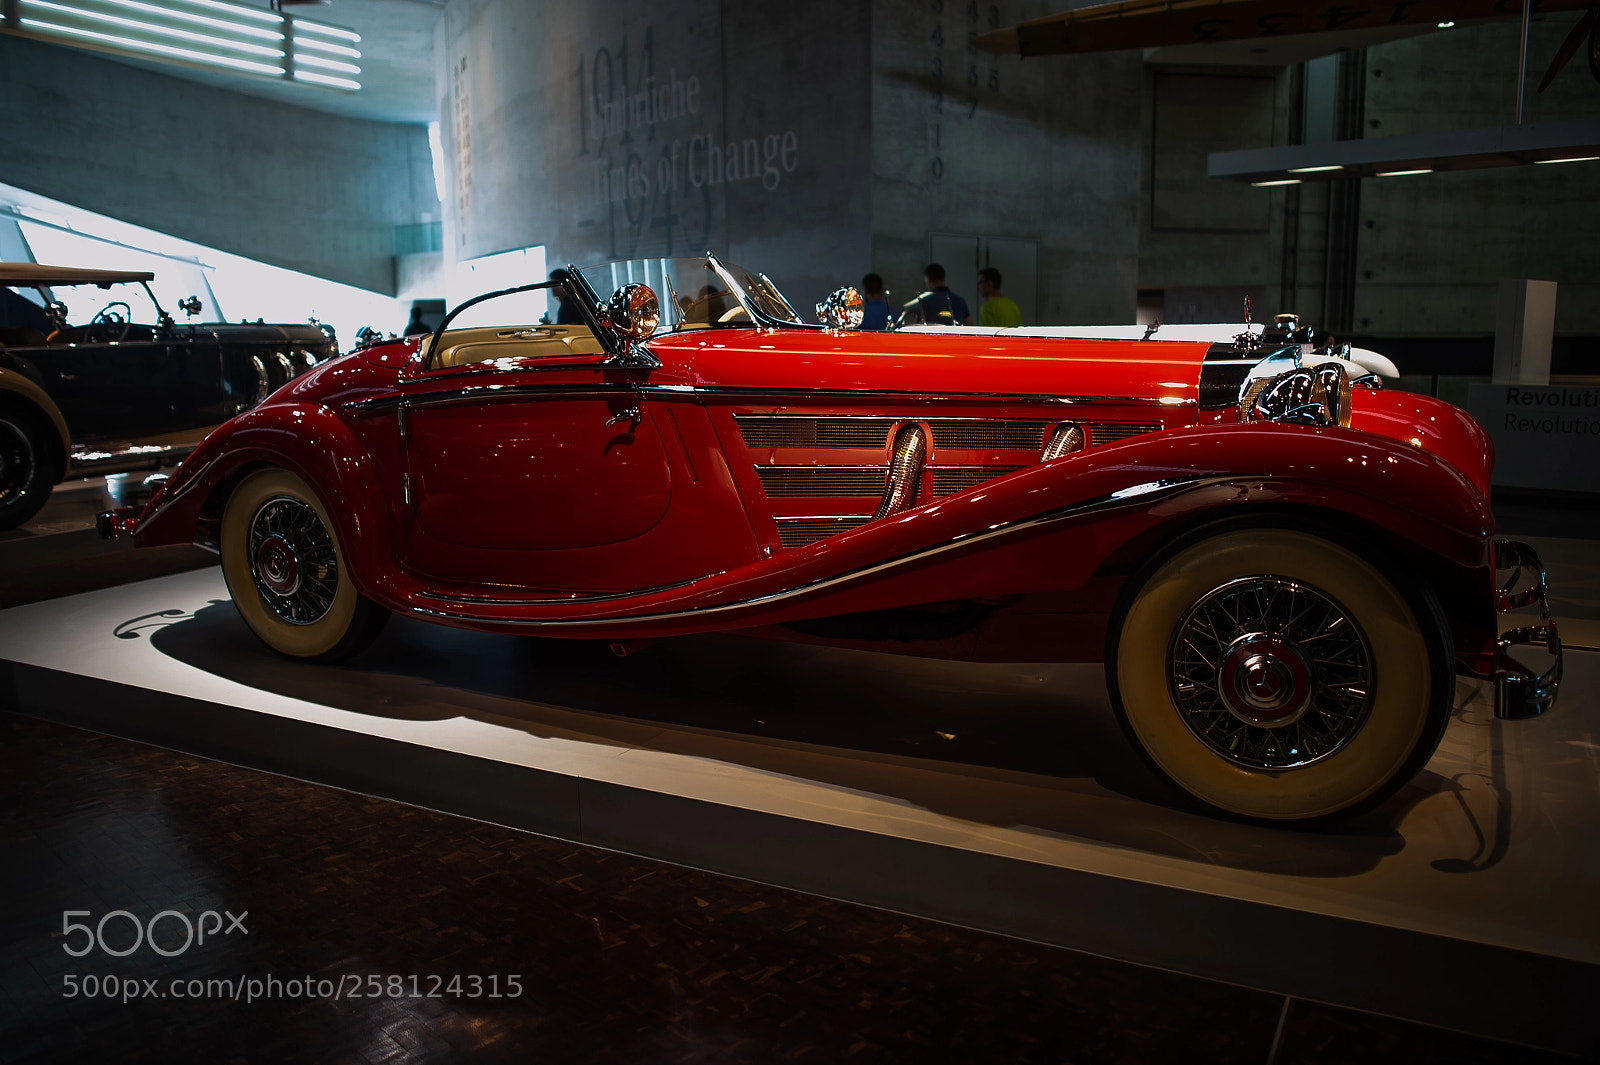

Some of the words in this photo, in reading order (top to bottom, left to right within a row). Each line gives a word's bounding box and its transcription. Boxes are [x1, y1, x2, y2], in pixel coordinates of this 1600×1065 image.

[594, 158, 650, 203] Times
[658, 138, 680, 194] of
[688, 131, 799, 191] Change
